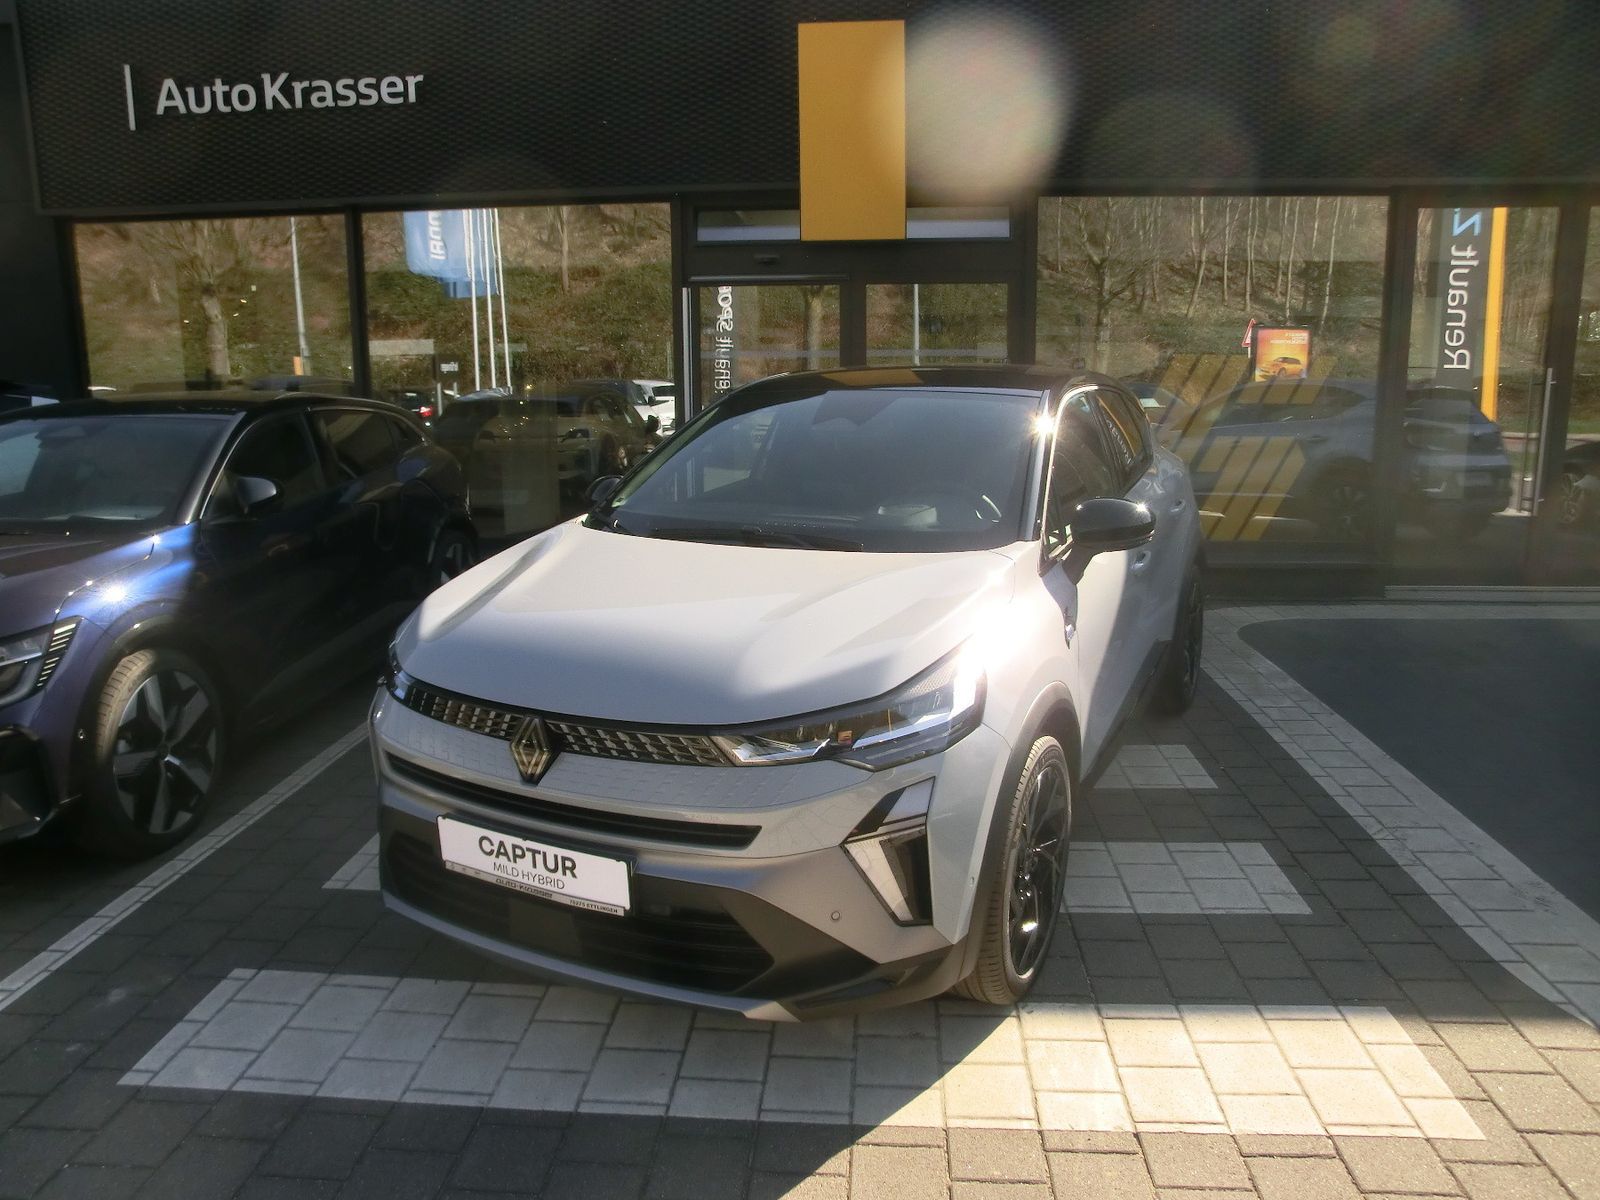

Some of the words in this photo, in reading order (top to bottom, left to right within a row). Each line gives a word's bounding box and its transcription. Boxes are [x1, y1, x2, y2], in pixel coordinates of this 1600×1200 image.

[156, 78, 257, 115] Auto
[261, 72, 424, 110] Krasser
[478, 836, 578, 879] CAPTUR
[493, 861, 520, 878] MILD
[521, 869, 565, 890] HYBRID
